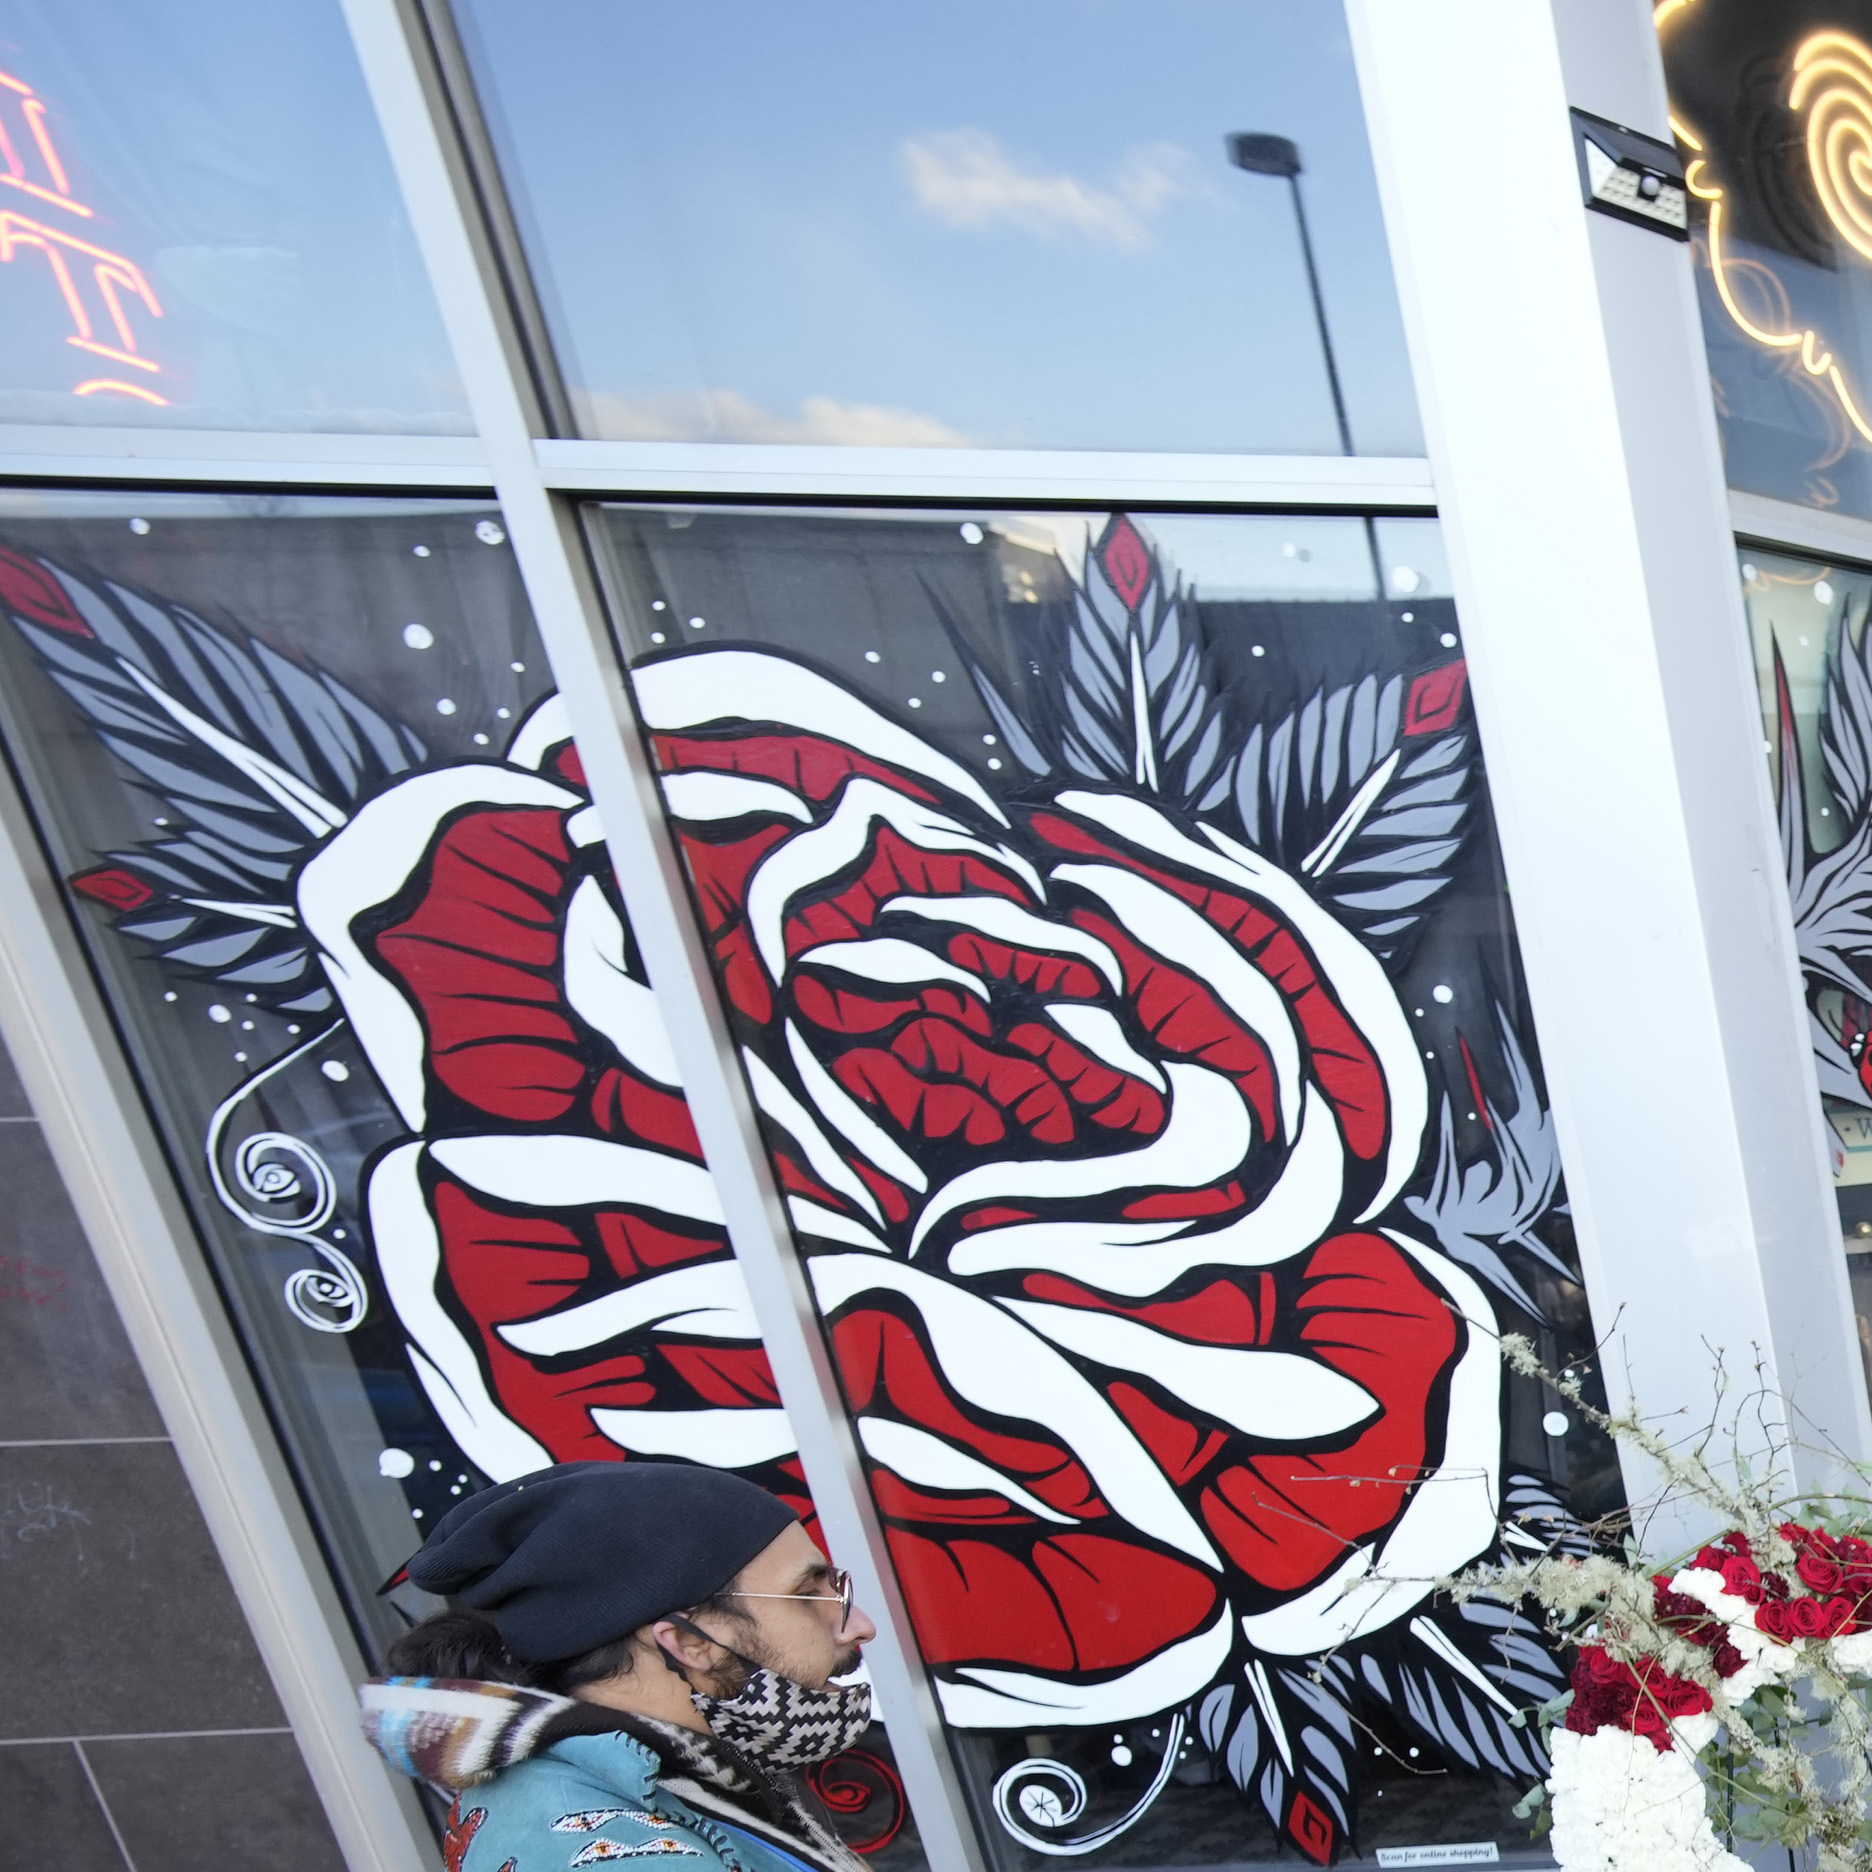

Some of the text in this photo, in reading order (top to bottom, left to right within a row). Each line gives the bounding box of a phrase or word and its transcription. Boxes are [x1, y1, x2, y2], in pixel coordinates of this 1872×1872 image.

[1405, 1851, 1416, 1864] for
[1420, 1849, 1447, 1859] online
[1450, 1846, 1493, 1859] shopping!
